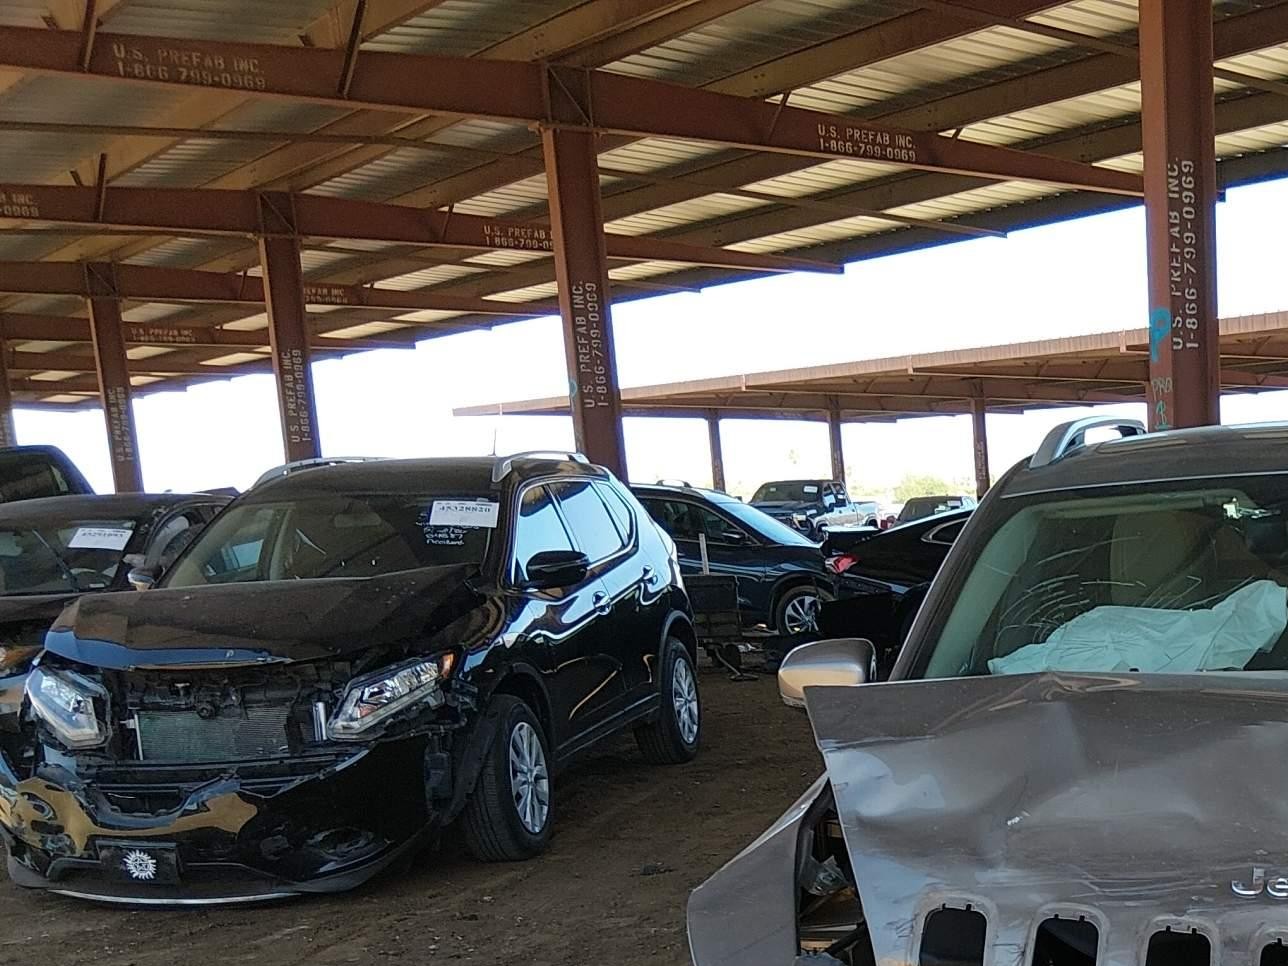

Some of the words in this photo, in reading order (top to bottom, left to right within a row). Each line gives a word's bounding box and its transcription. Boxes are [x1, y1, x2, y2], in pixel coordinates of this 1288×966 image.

[158, 49, 225, 70] PREFAB
[818, 124, 841, 138] U.S.
[846, 128, 890, 145] PREFAB
[895, 134, 916, 149] INC.
[820, 138, 916, 161] 1-866-799-0969
[508, 227, 546, 239] PREFAB
[1181, 160, 1199, 348] 1-866-799-0969
[572, 281, 584, 308] INC.
[576, 316, 593, 373] PREFAB
[585, 282, 609, 407] 1-866-799-0969
[284, 374, 298, 417] PREFAB
